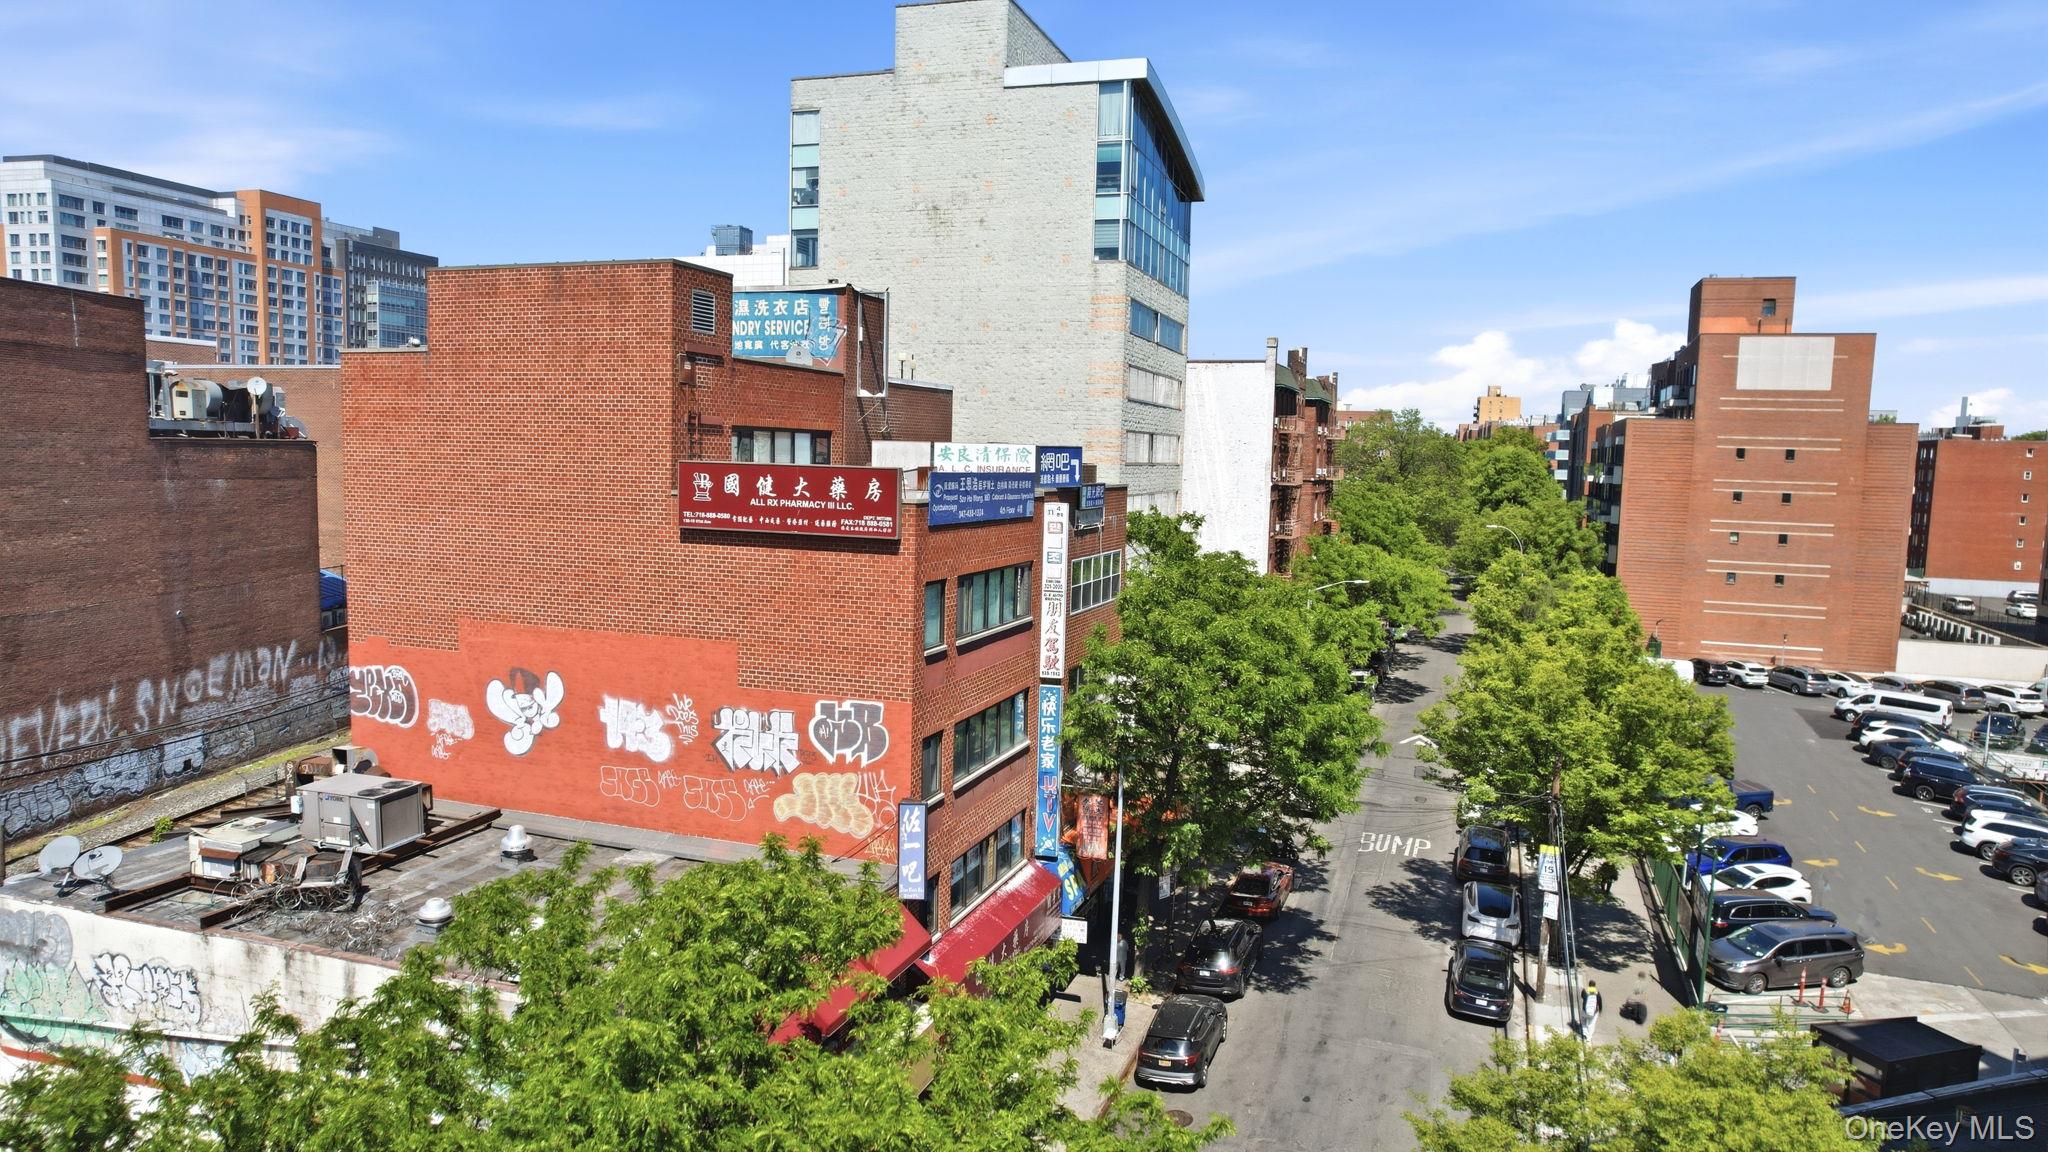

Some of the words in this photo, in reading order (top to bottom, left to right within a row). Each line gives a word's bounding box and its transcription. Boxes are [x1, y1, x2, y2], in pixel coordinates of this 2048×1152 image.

[937, 445, 1032, 464] 安良清保險
[1040, 452, 1070, 472] 網吧
[976, 465, 1031, 473] INSURANCE
[724, 472, 883, 503] 國健大藥房
[750, 498, 766, 507] ALL
[767, 499, 779, 507] RX
[780, 499, 827, 509] PHARMACY
[836, 501, 855, 511] LLC.
[1040, 695, 1057, 769] 快乐老家
[1040, 775, 1058, 833] KTV
[1358, 832, 1432, 859] BUMP
